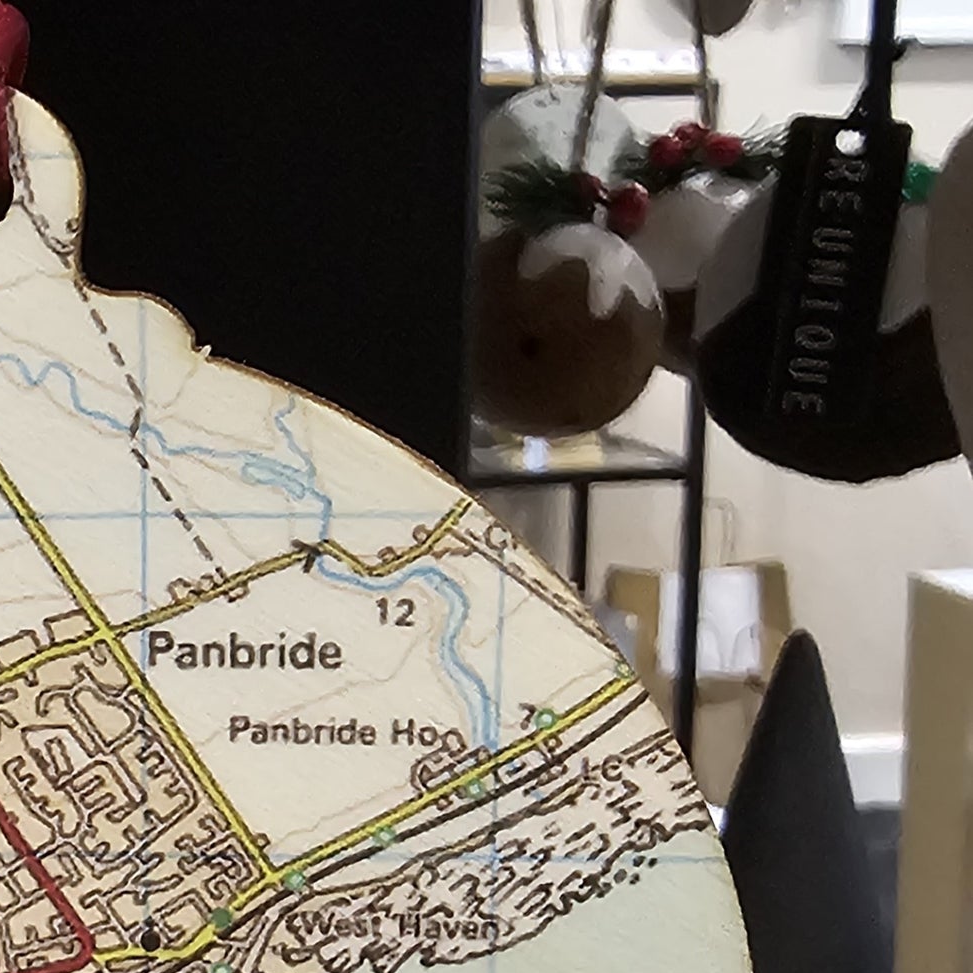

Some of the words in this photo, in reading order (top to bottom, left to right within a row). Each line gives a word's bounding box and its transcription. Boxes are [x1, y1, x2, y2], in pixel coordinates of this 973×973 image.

[376, 597, 417, 627] 12
[147, 630, 343, 670] Panbride
[228, 715, 377, 746] Panbride
[398, 913, 500, 941] Haven
